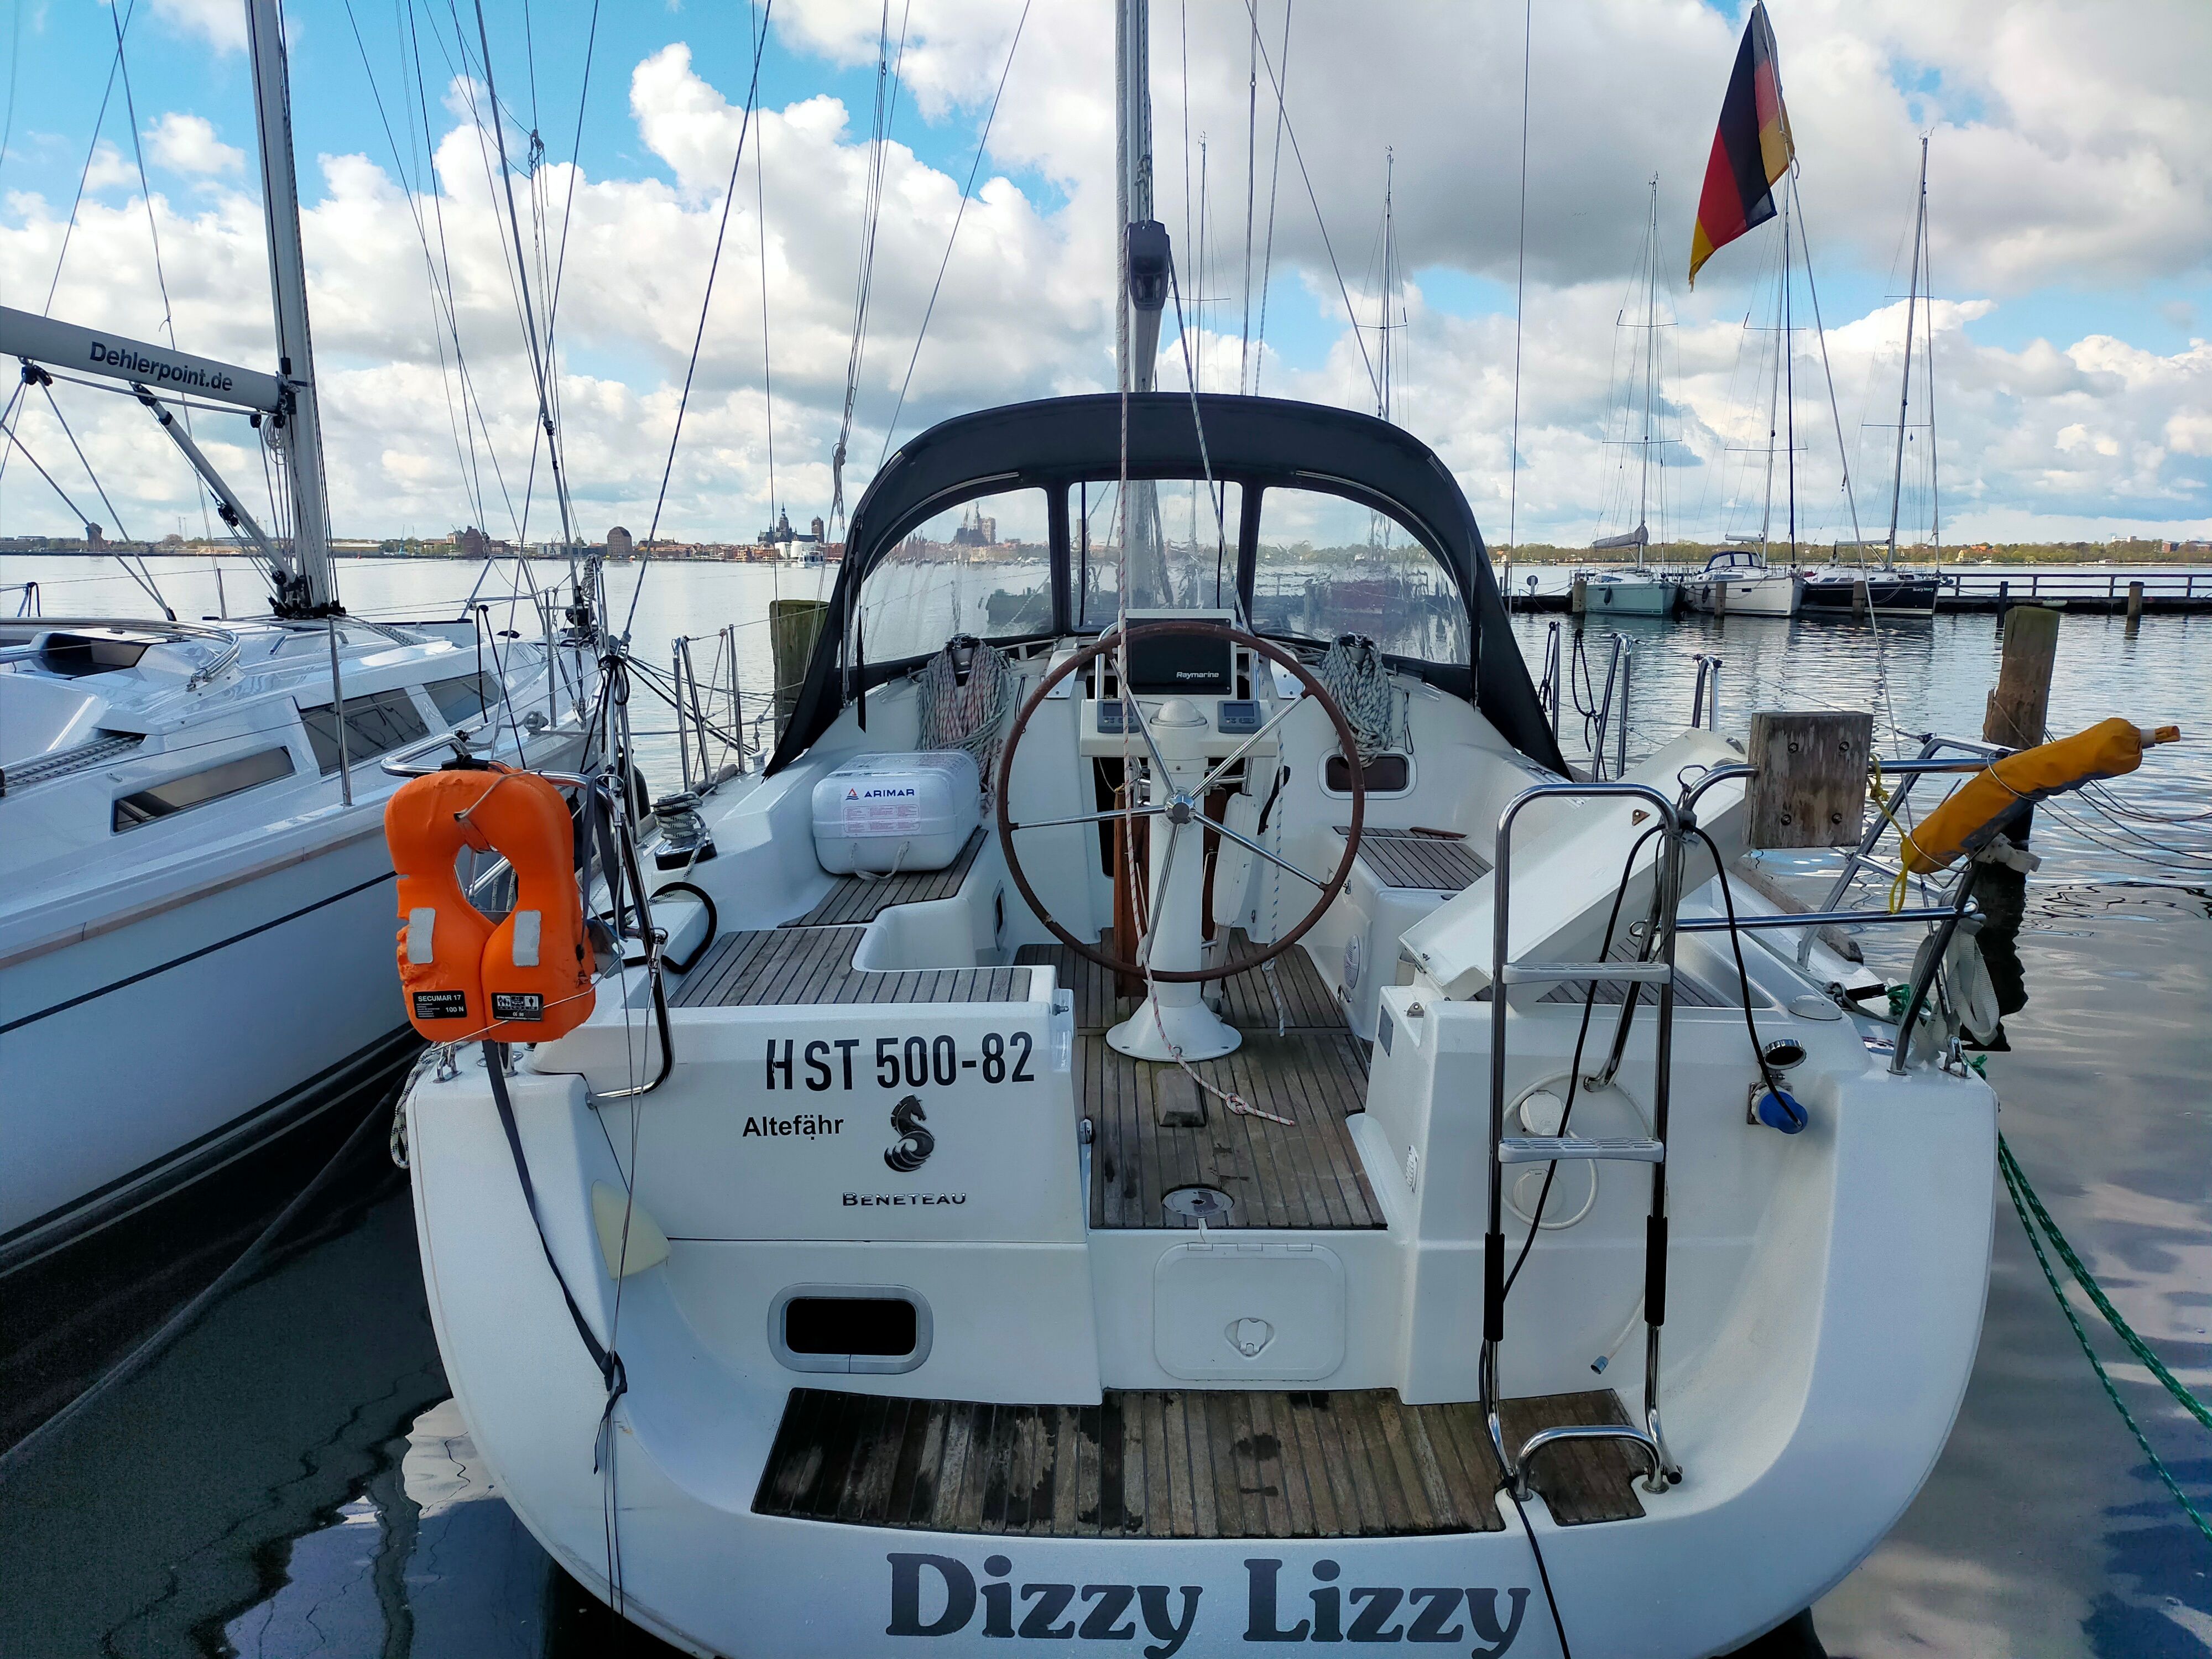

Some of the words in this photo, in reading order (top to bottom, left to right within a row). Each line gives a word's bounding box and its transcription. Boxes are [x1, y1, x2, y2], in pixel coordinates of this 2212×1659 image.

[90, 341, 232, 391] Dehlerpoint.de
[864, 789, 915, 797] ARIMAR
[766, 1039, 860, 1092] HST
[876, 1031, 1035, 1088] 500-82
[742, 1114, 844, 1140] Altefähr
[842, 1192, 966, 1207] BENETEAU
[885, 1553, 1203, 1659] Dizzy
[1243, 1558, 1531, 1659] Lizzy
